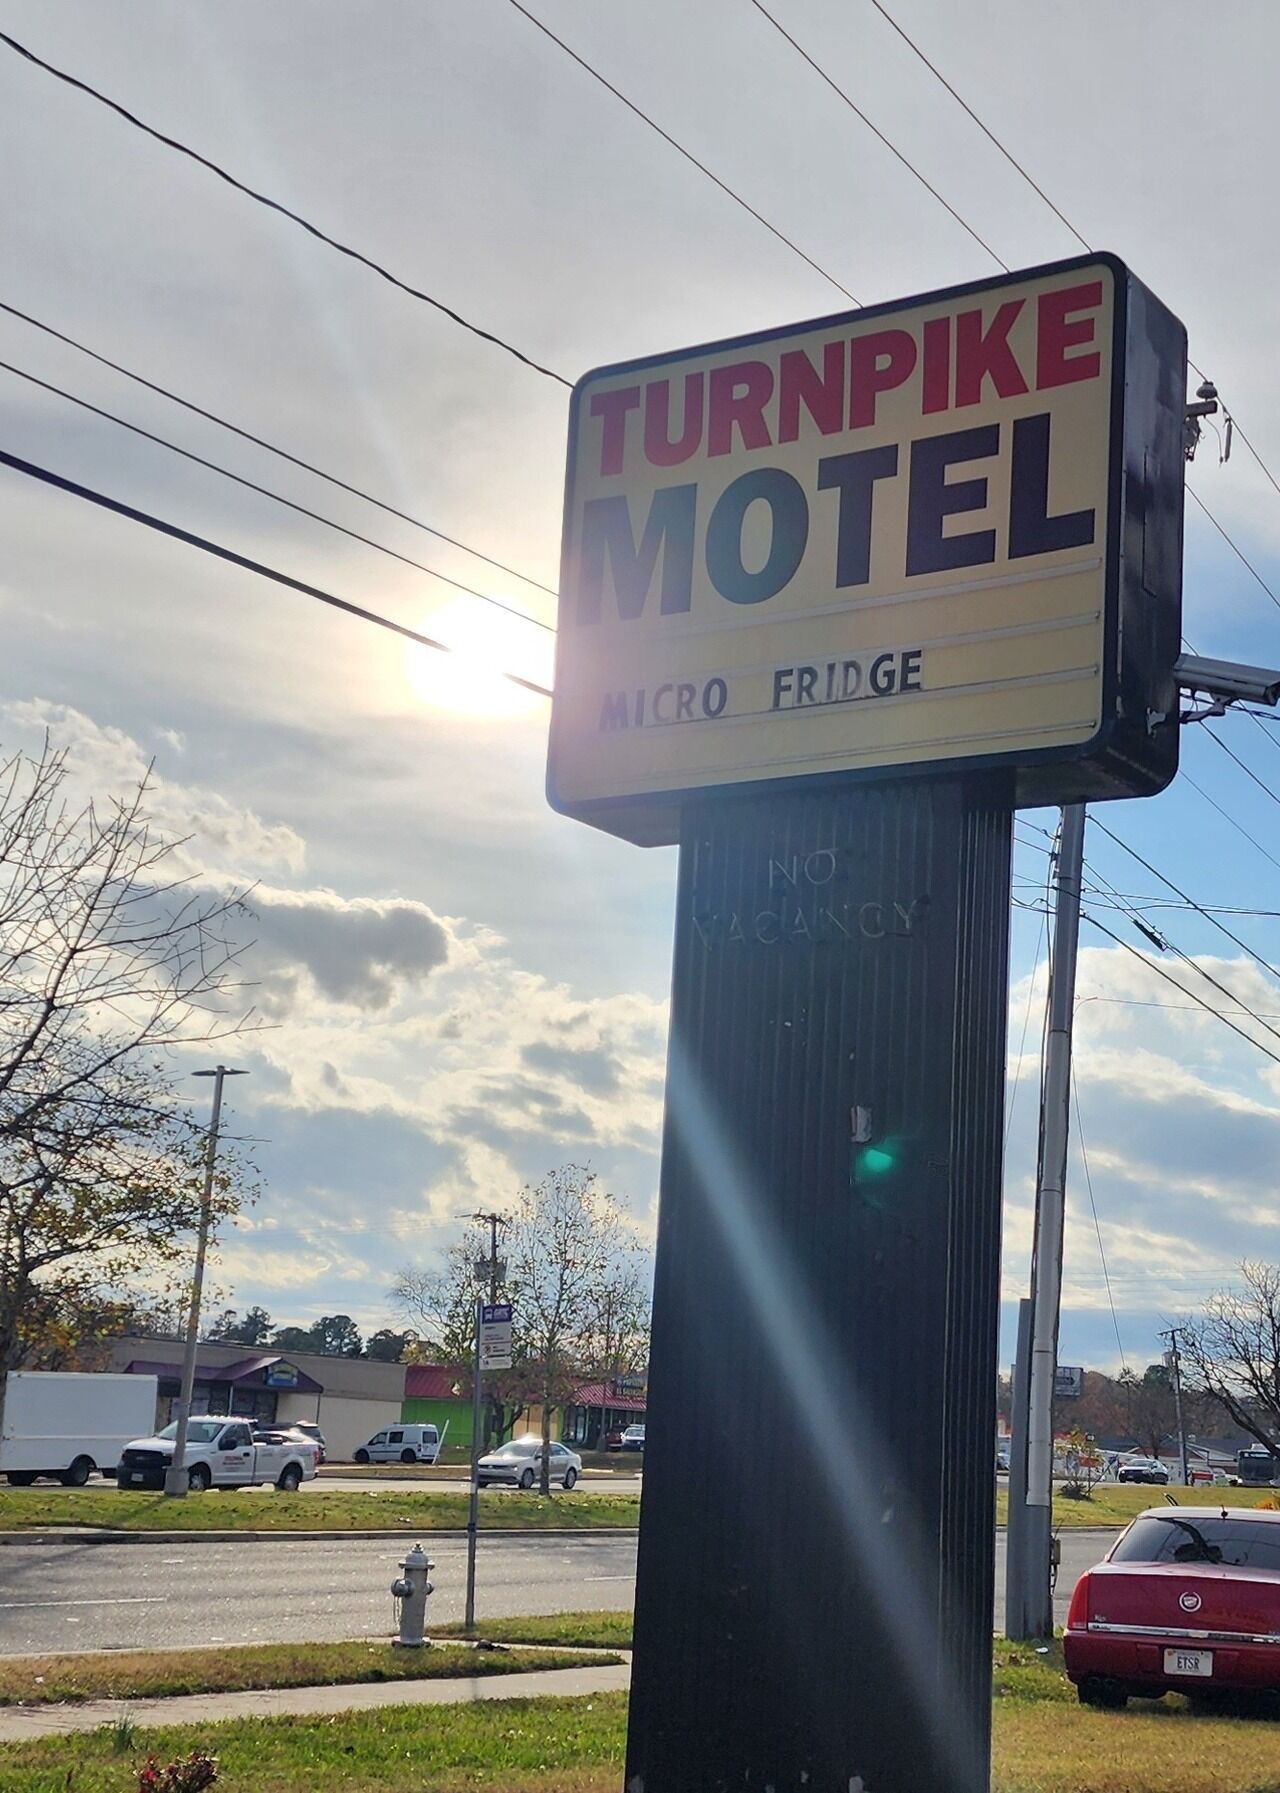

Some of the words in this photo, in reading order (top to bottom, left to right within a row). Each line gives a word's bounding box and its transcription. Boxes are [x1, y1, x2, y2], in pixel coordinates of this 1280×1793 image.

[589, 279, 1104, 477] TURNPIKE
[575, 411, 1096, 627] MOTEL
[597, 676, 729, 731] MICRO
[771, 649, 923, 710] FRIDGE
[769, 847, 837, 888] NO
